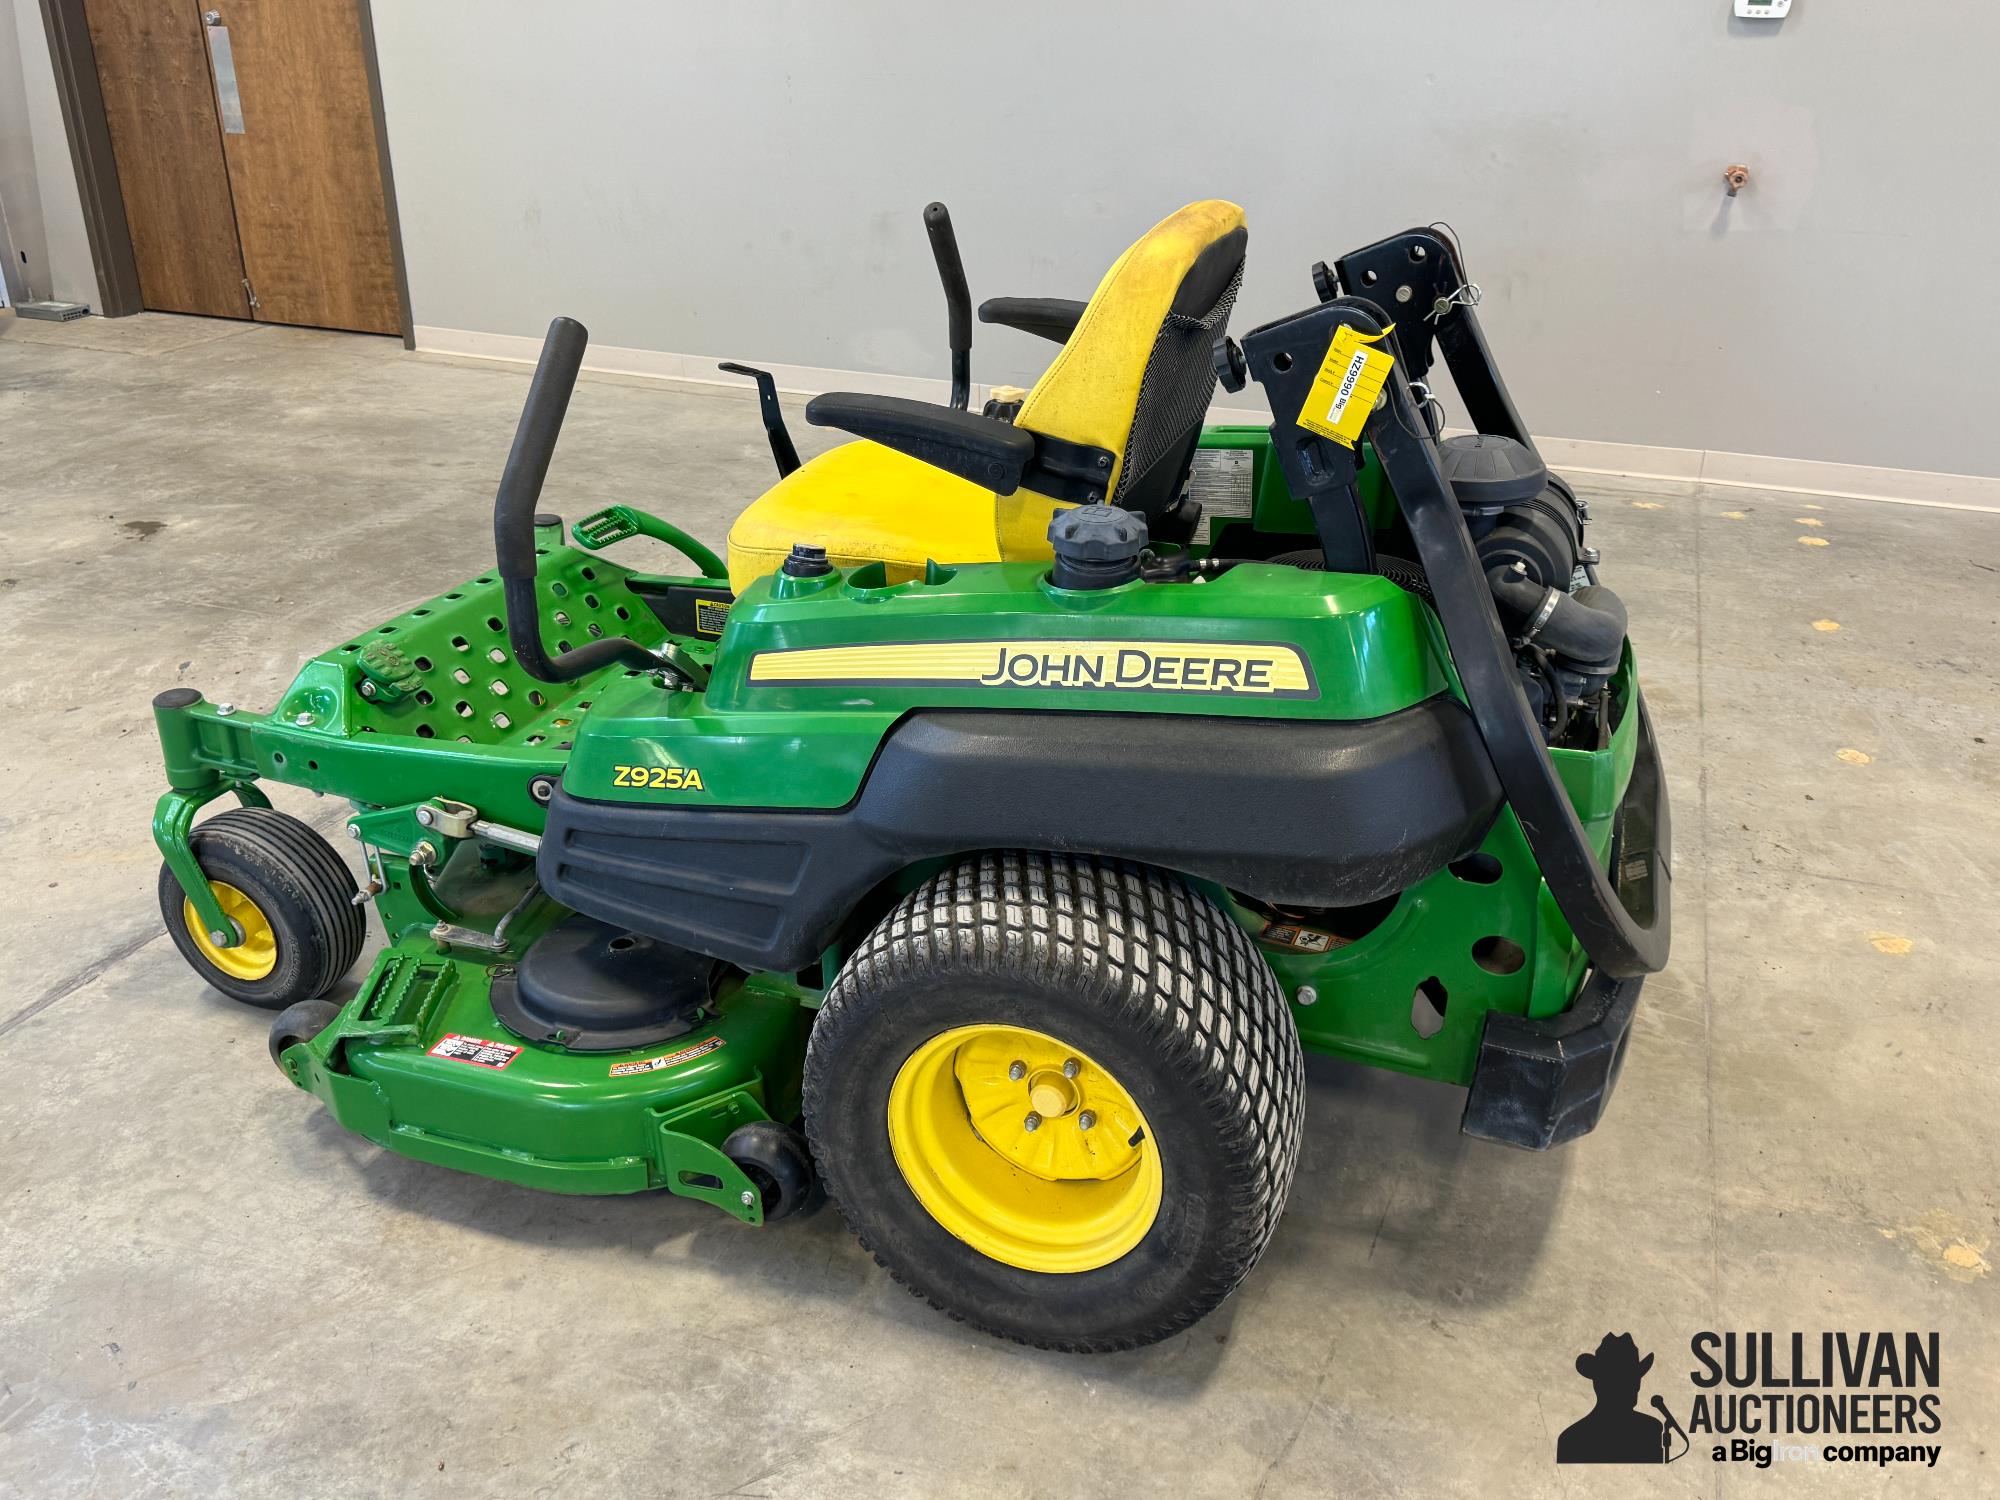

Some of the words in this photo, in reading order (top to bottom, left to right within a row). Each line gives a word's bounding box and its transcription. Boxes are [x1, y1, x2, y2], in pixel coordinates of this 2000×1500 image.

[1341, 355, 1365, 396] HZ9990
[981, 647, 1104, 684] JOHN
[1115, 649, 1274, 689] DEERE
[613, 765, 704, 791] Z925A
